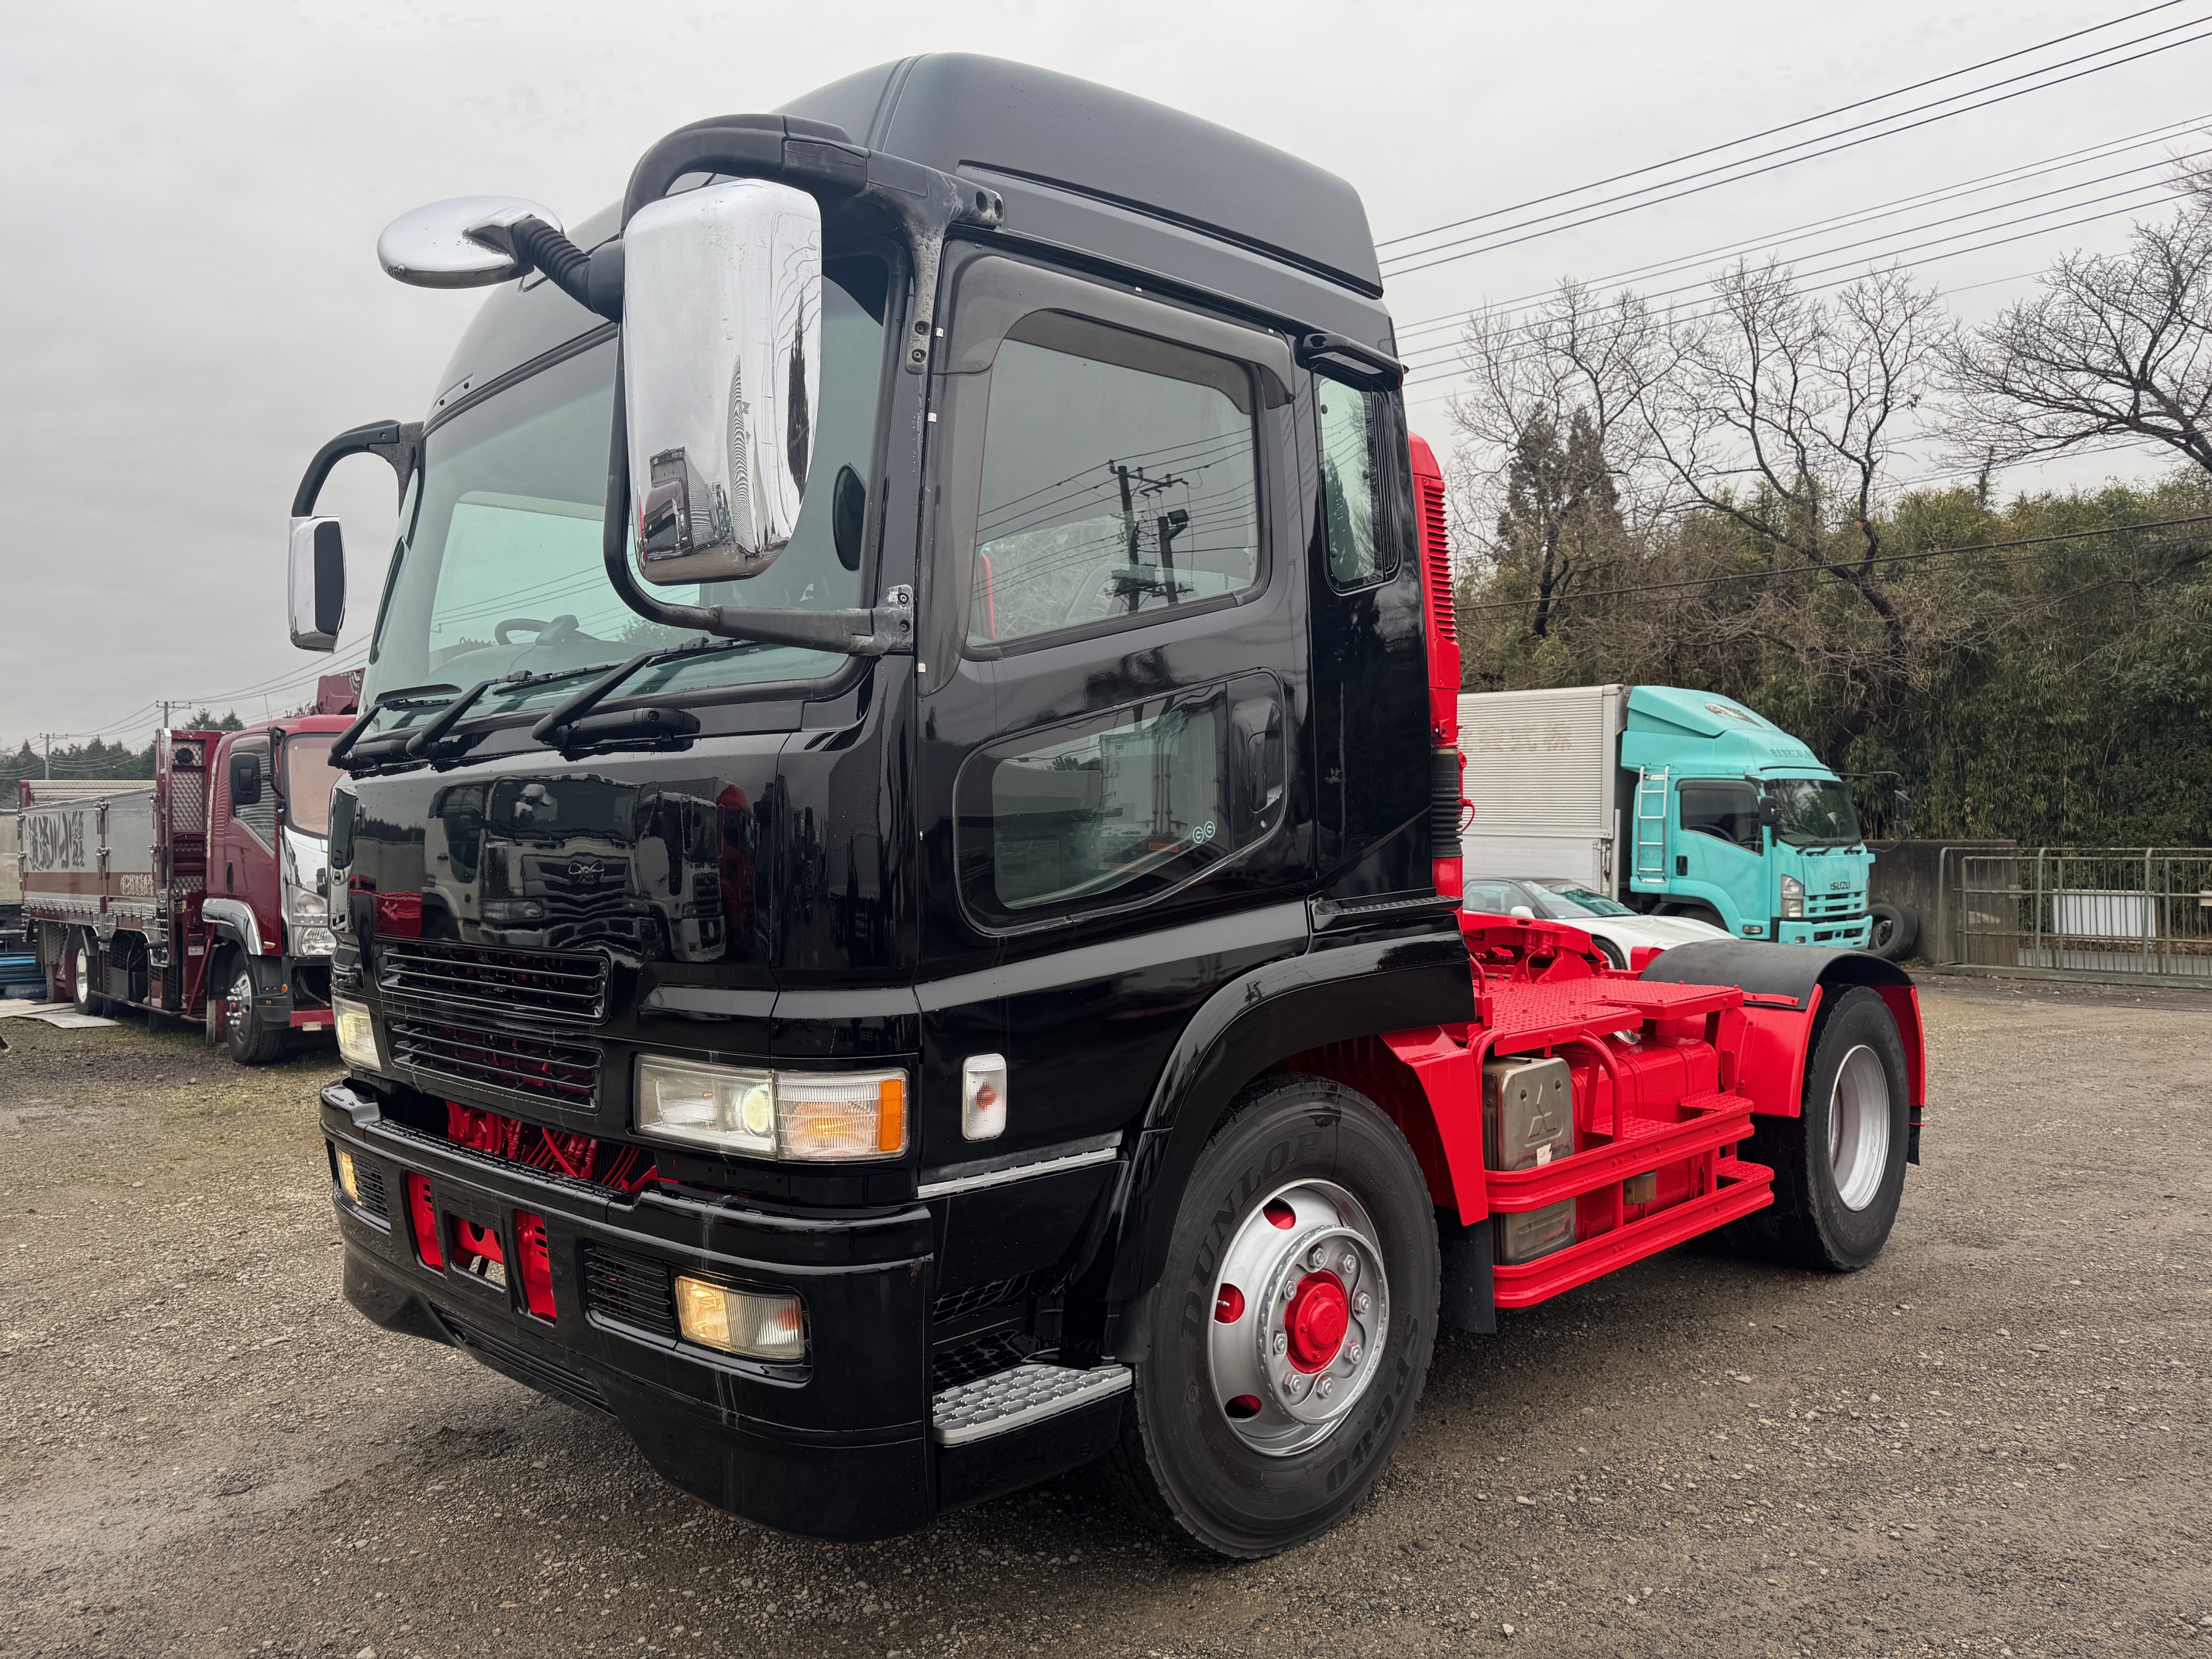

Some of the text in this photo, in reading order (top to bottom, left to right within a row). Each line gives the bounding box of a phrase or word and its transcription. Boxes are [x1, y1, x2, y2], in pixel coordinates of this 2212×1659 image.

[1829, 881, 1850, 891] ISUZU
[1181, 1130, 1323, 1340] DUNLOP
[1326, 1312, 1419, 1495] SP680
